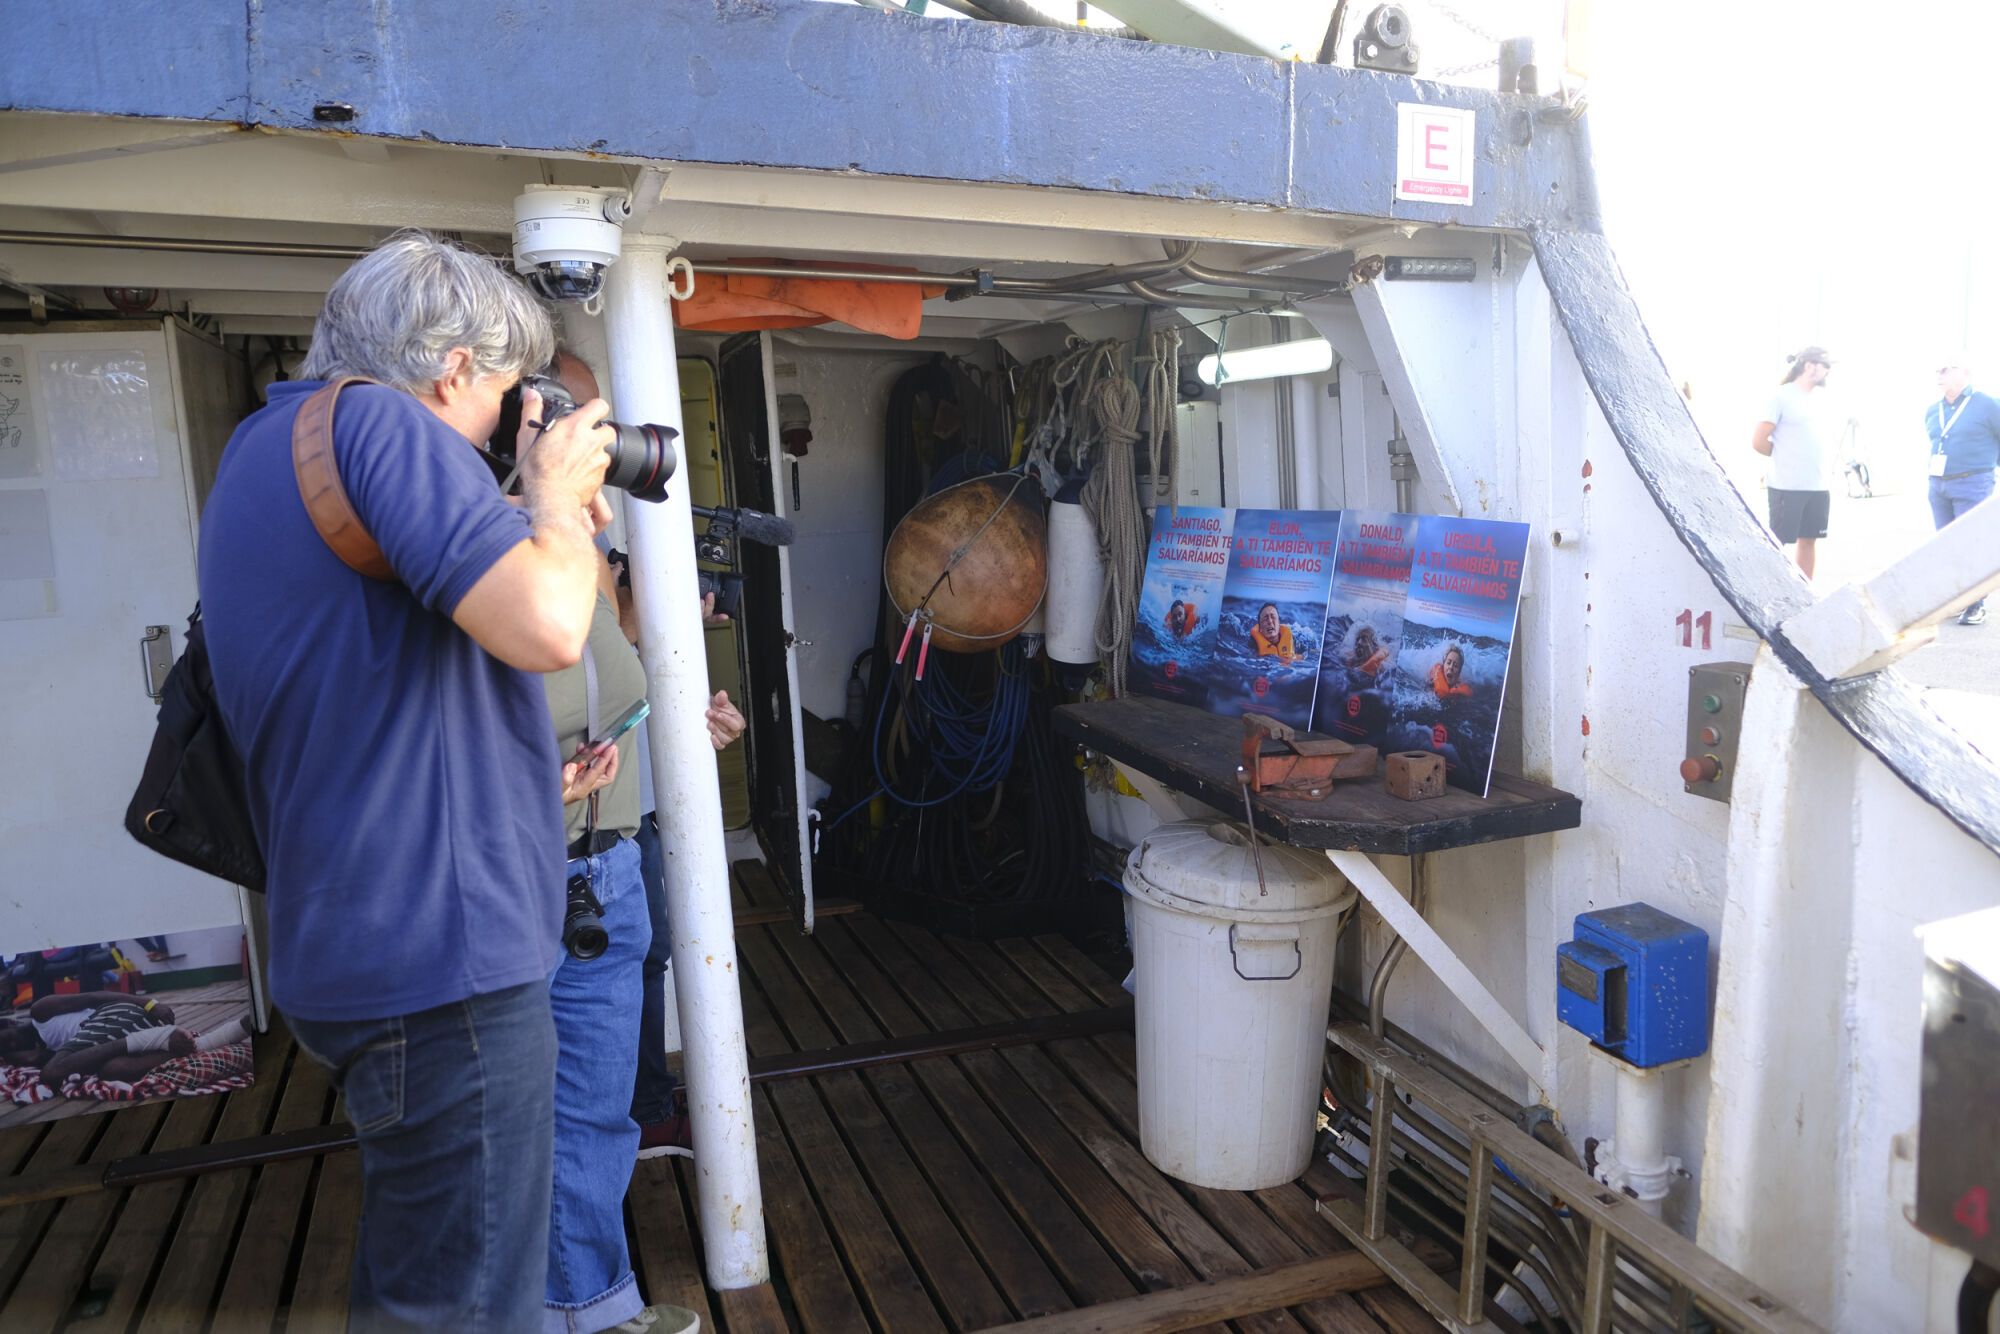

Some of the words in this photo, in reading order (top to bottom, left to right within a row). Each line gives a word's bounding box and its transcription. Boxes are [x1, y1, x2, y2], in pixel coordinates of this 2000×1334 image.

[1425, 124, 1449, 170] E
[1409, 182, 1443, 195] Emergency
[1171, 517, 1222, 533] SANTIAGO,
[1269, 519, 1304, 537] ELON,
[1360, 523, 1405, 544] DONALD,
[1155, 534, 1162, 543] A
[1165, 533, 1173, 544] TI
[1176, 532, 1217, 547] TAMBIÉN
[1236, 540, 1245, 550] A
[1248, 538, 1259, 551] TI
[1261, 537, 1314, 554] TAMBIÉN
[1317, 540, 1331, 556] TE
[1444, 531, 1497, 555] URSULA,
[1158, 546, 1225, 565] SALVARÍAMOS
[1339, 542, 1346, 554] A
[1350, 541, 1358, 555] TI
[1361, 542, 1407, 562] TAMBIÉN
[1240, 554, 1322, 573] SALVARÍAMOS
[1342, 560, 1411, 583] SALVARÍAMOS
[1418, 552, 1427, 567] A
[1430, 552, 1442, 568] TI
[1443, 552, 1501, 577] TAMBIÉN
[1503, 560, 1519, 580] TE
[1421, 572, 1509, 600] SALVARÍAMOS
[1675, 608, 1712, 650] 11
